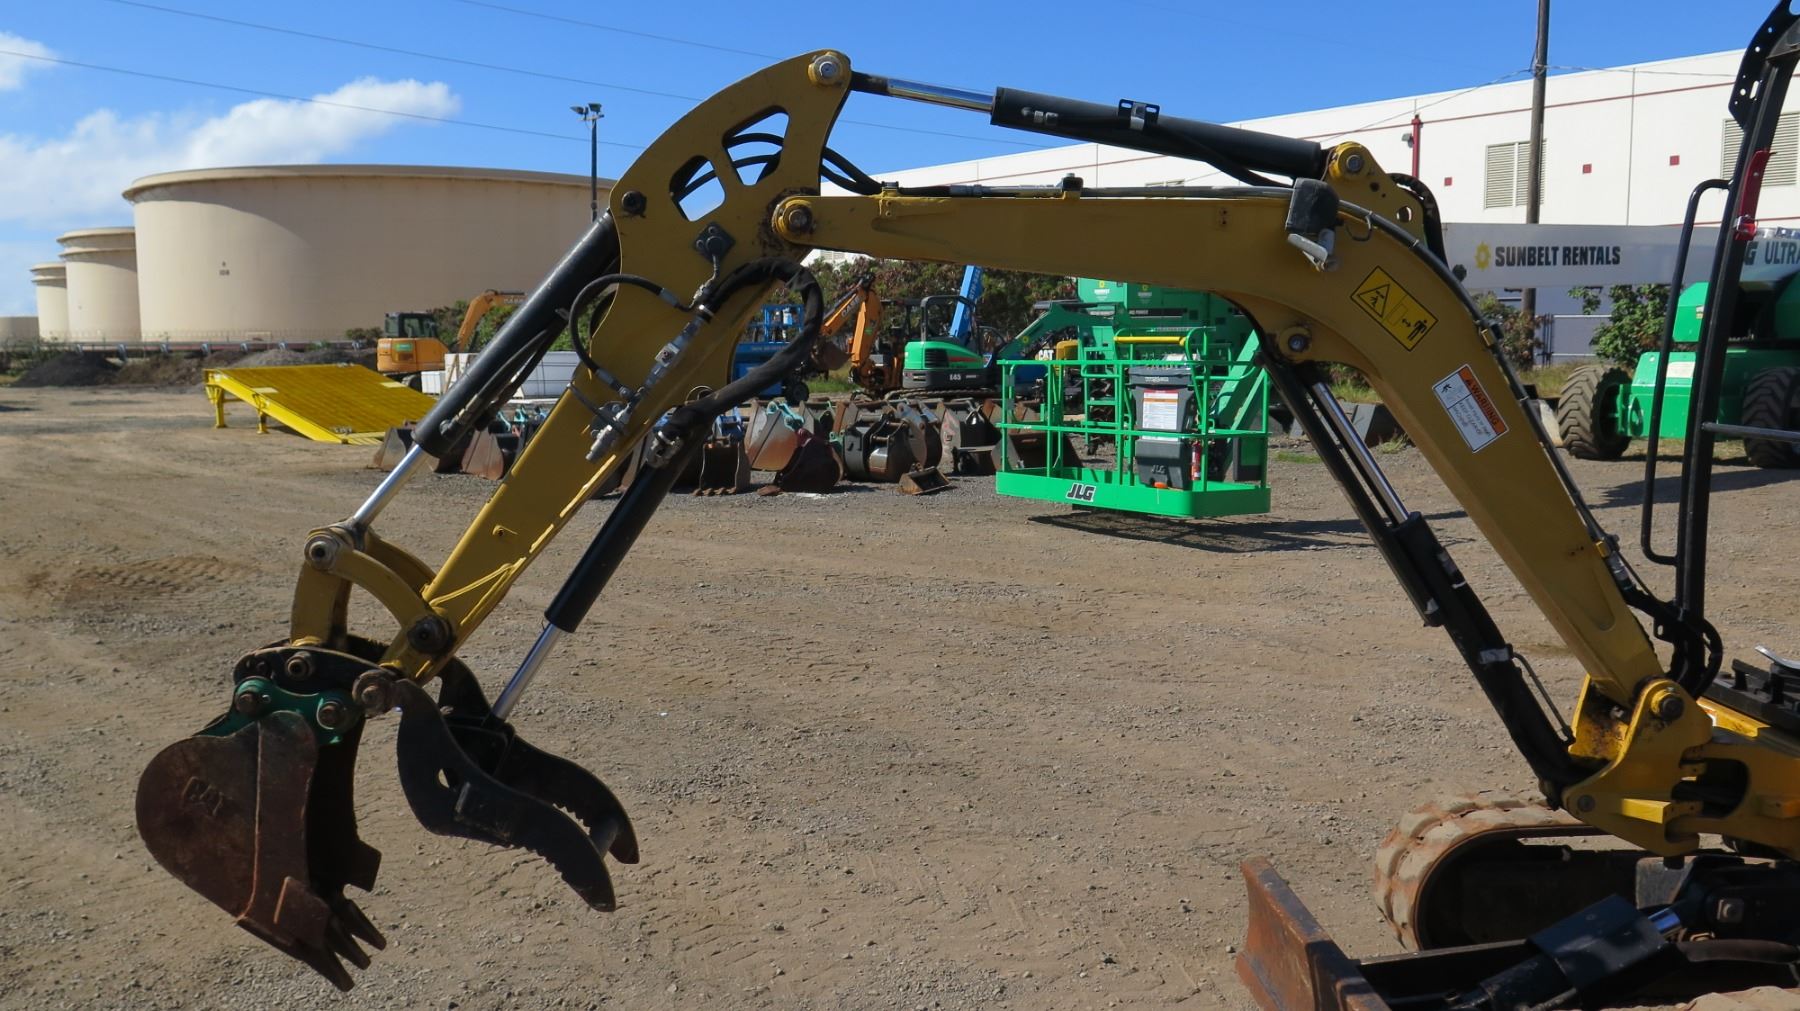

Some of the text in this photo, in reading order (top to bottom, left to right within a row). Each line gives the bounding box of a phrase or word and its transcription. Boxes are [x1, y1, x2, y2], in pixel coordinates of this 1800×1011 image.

[1495, 246, 1621, 267] SUNBELT RENTALS
[1470, 383, 1500, 426] WARNING
[1066, 482, 1097, 502] JLG
